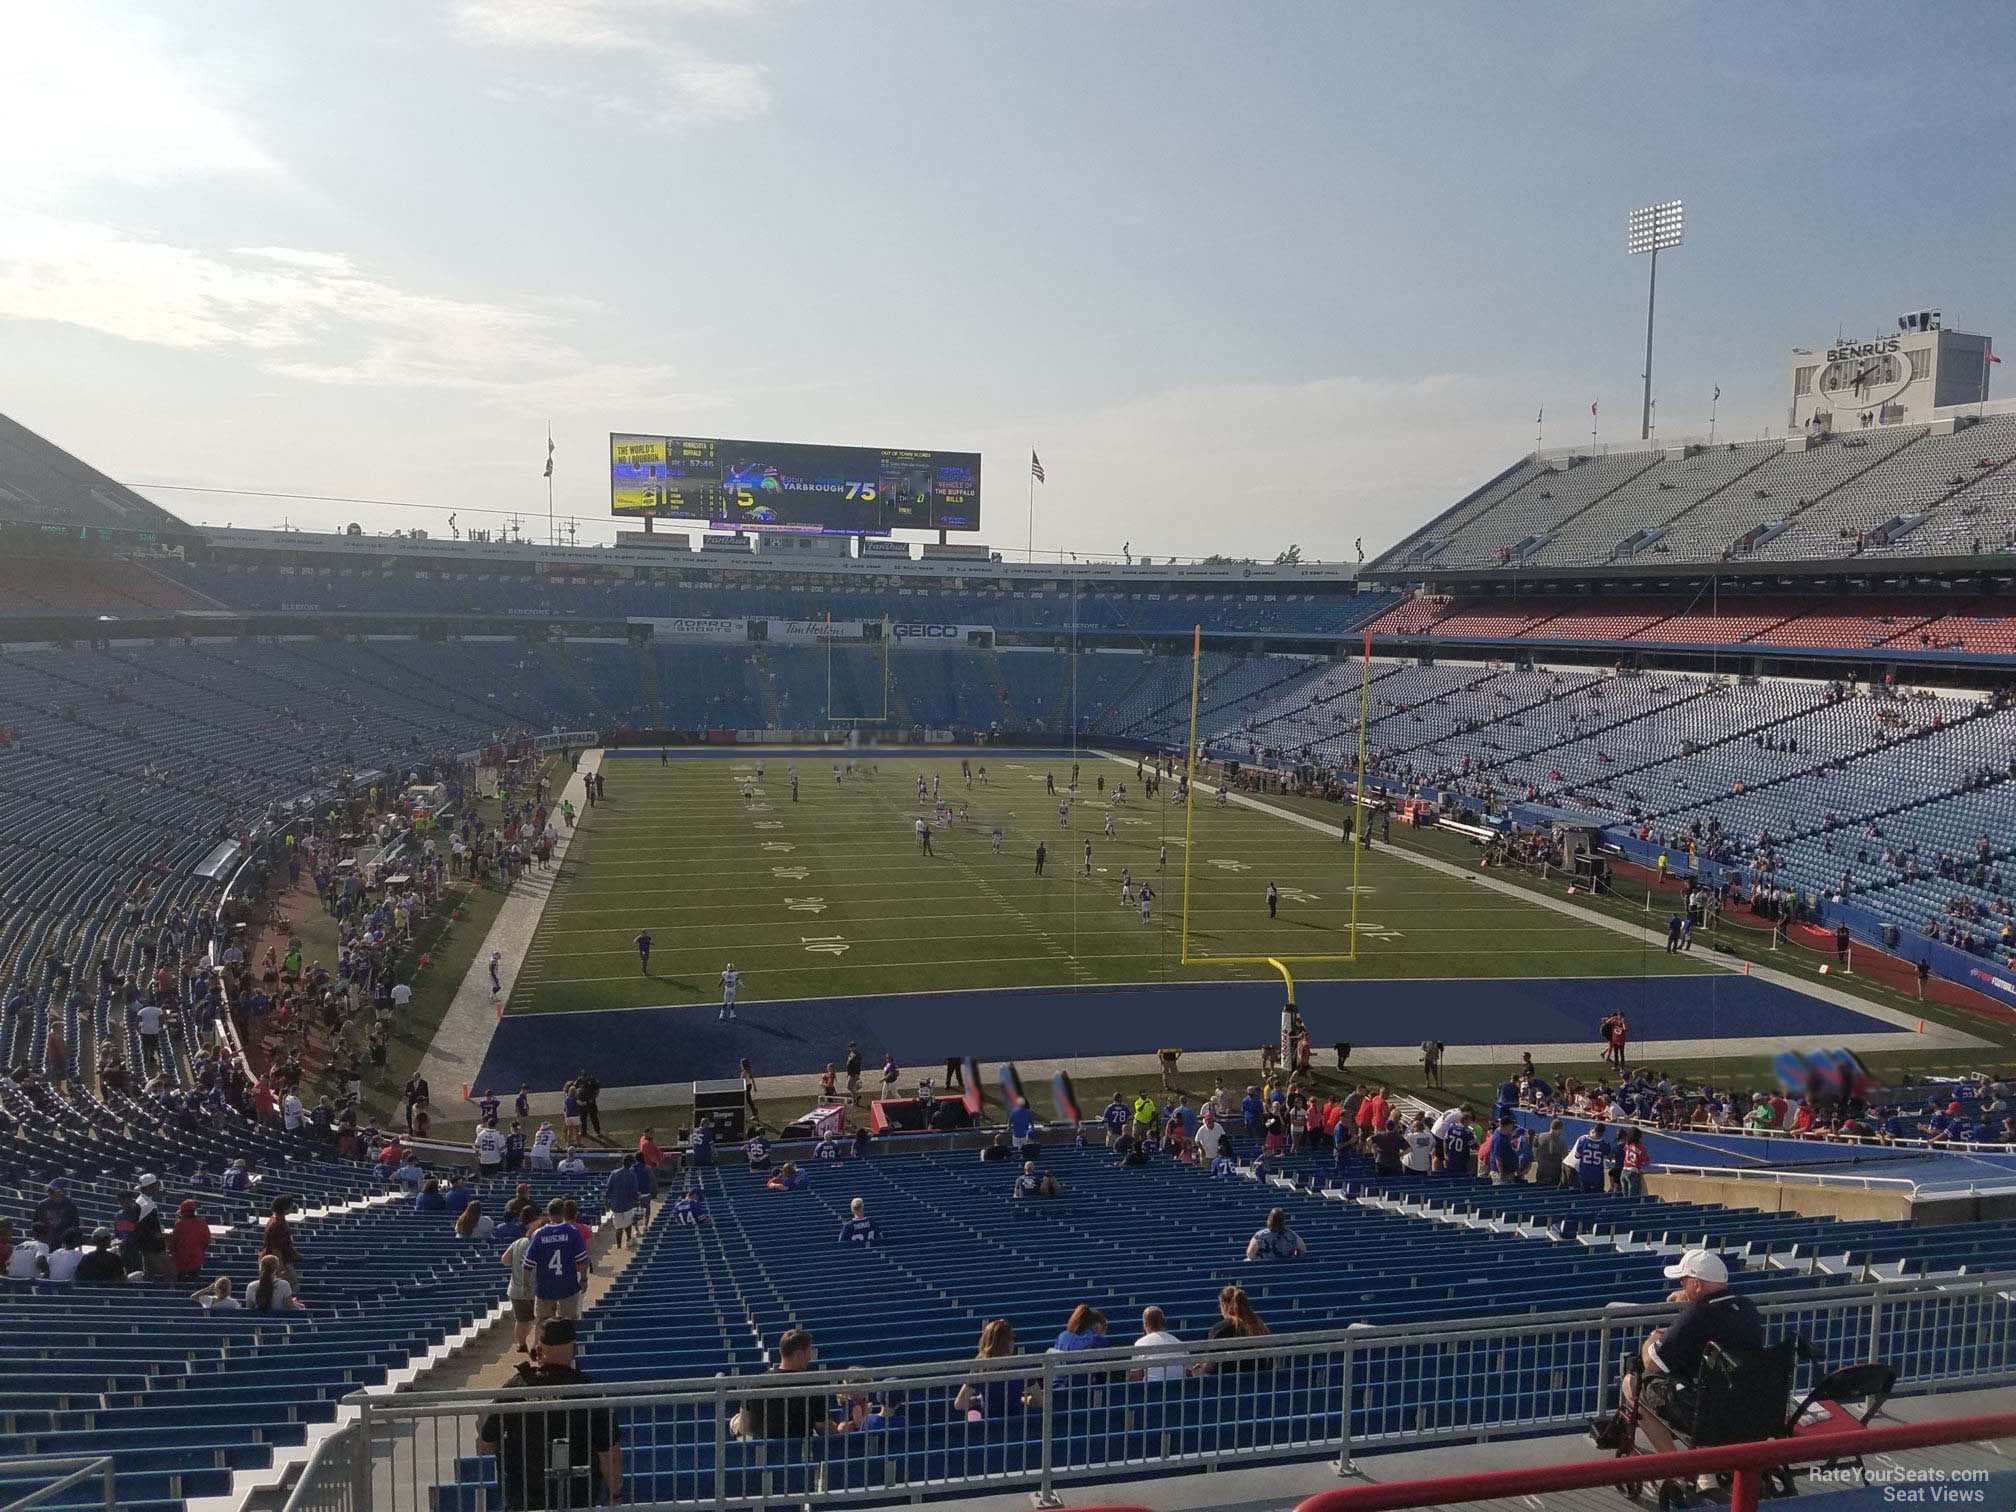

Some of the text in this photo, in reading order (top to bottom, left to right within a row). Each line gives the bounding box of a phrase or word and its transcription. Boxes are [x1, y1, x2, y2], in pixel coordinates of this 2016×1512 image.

[1827, 340, 1900, 362] BENRUS
[783, 481, 876, 501] YARBROUGH 75
[673, 619, 732, 628] ADPRO
[785, 622, 845, 636] Tim Hortons
[893, 624, 958, 638] GEICO
[1112, 1110, 1126, 1123] 78
[482, 1139, 495, 1151] 25
[750, 1143, 764, 1155] 25
[1448, 1135, 1463, 1152] 70
[1583, 1149, 1602, 1165] 25
[678, 1210, 697, 1225] 14
[548, 1249, 563, 1276] 4
